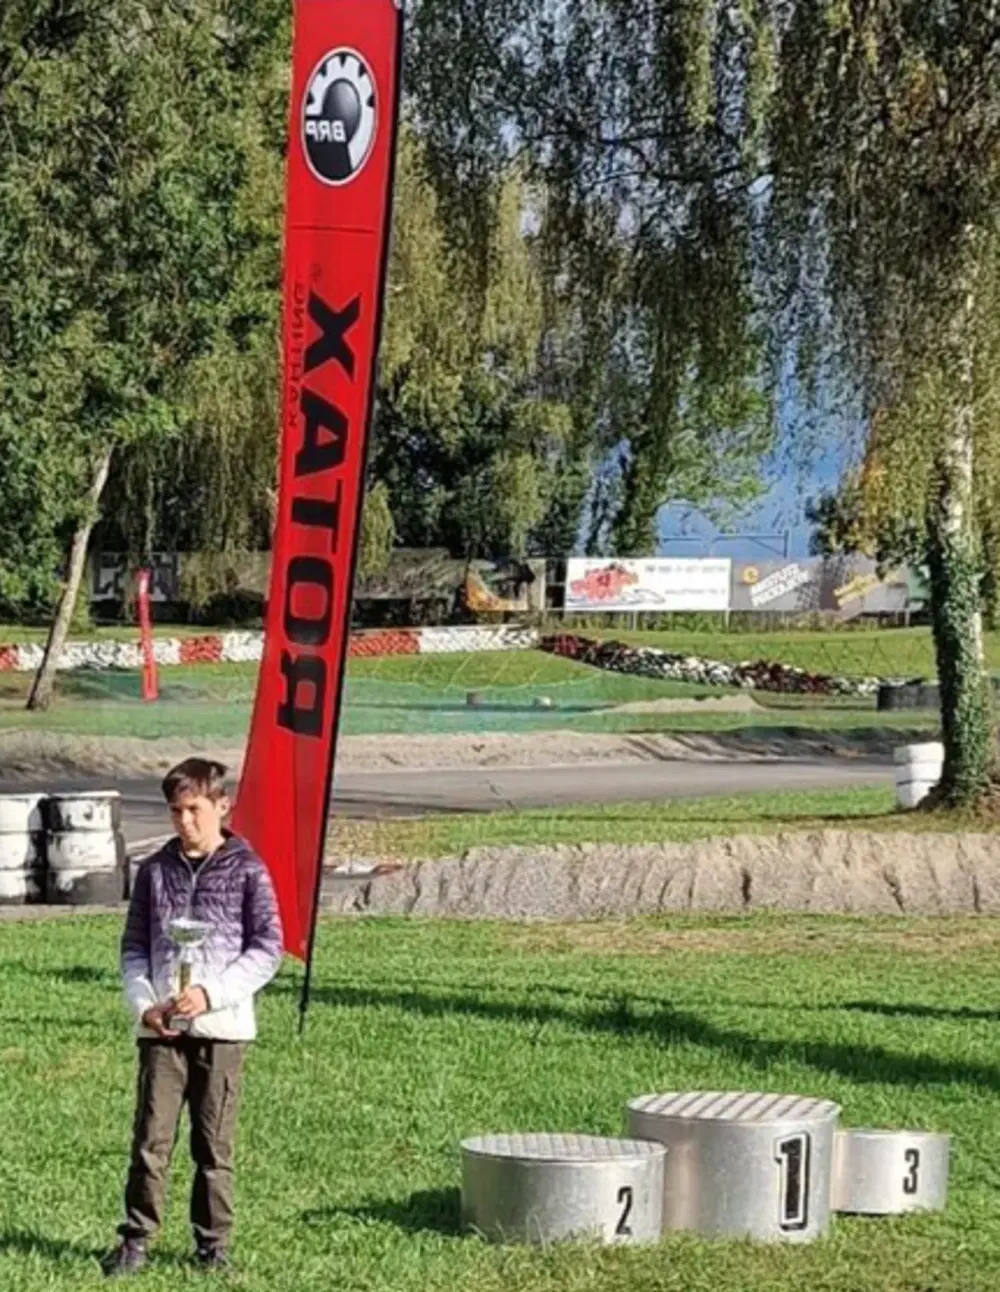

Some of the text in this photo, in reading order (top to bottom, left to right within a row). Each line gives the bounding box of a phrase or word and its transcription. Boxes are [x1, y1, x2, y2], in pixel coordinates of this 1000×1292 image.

[774, 1131, 811, 1231] 1
[903, 1148, 920, 1194] 3
[616, 1186, 633, 1235] 2
